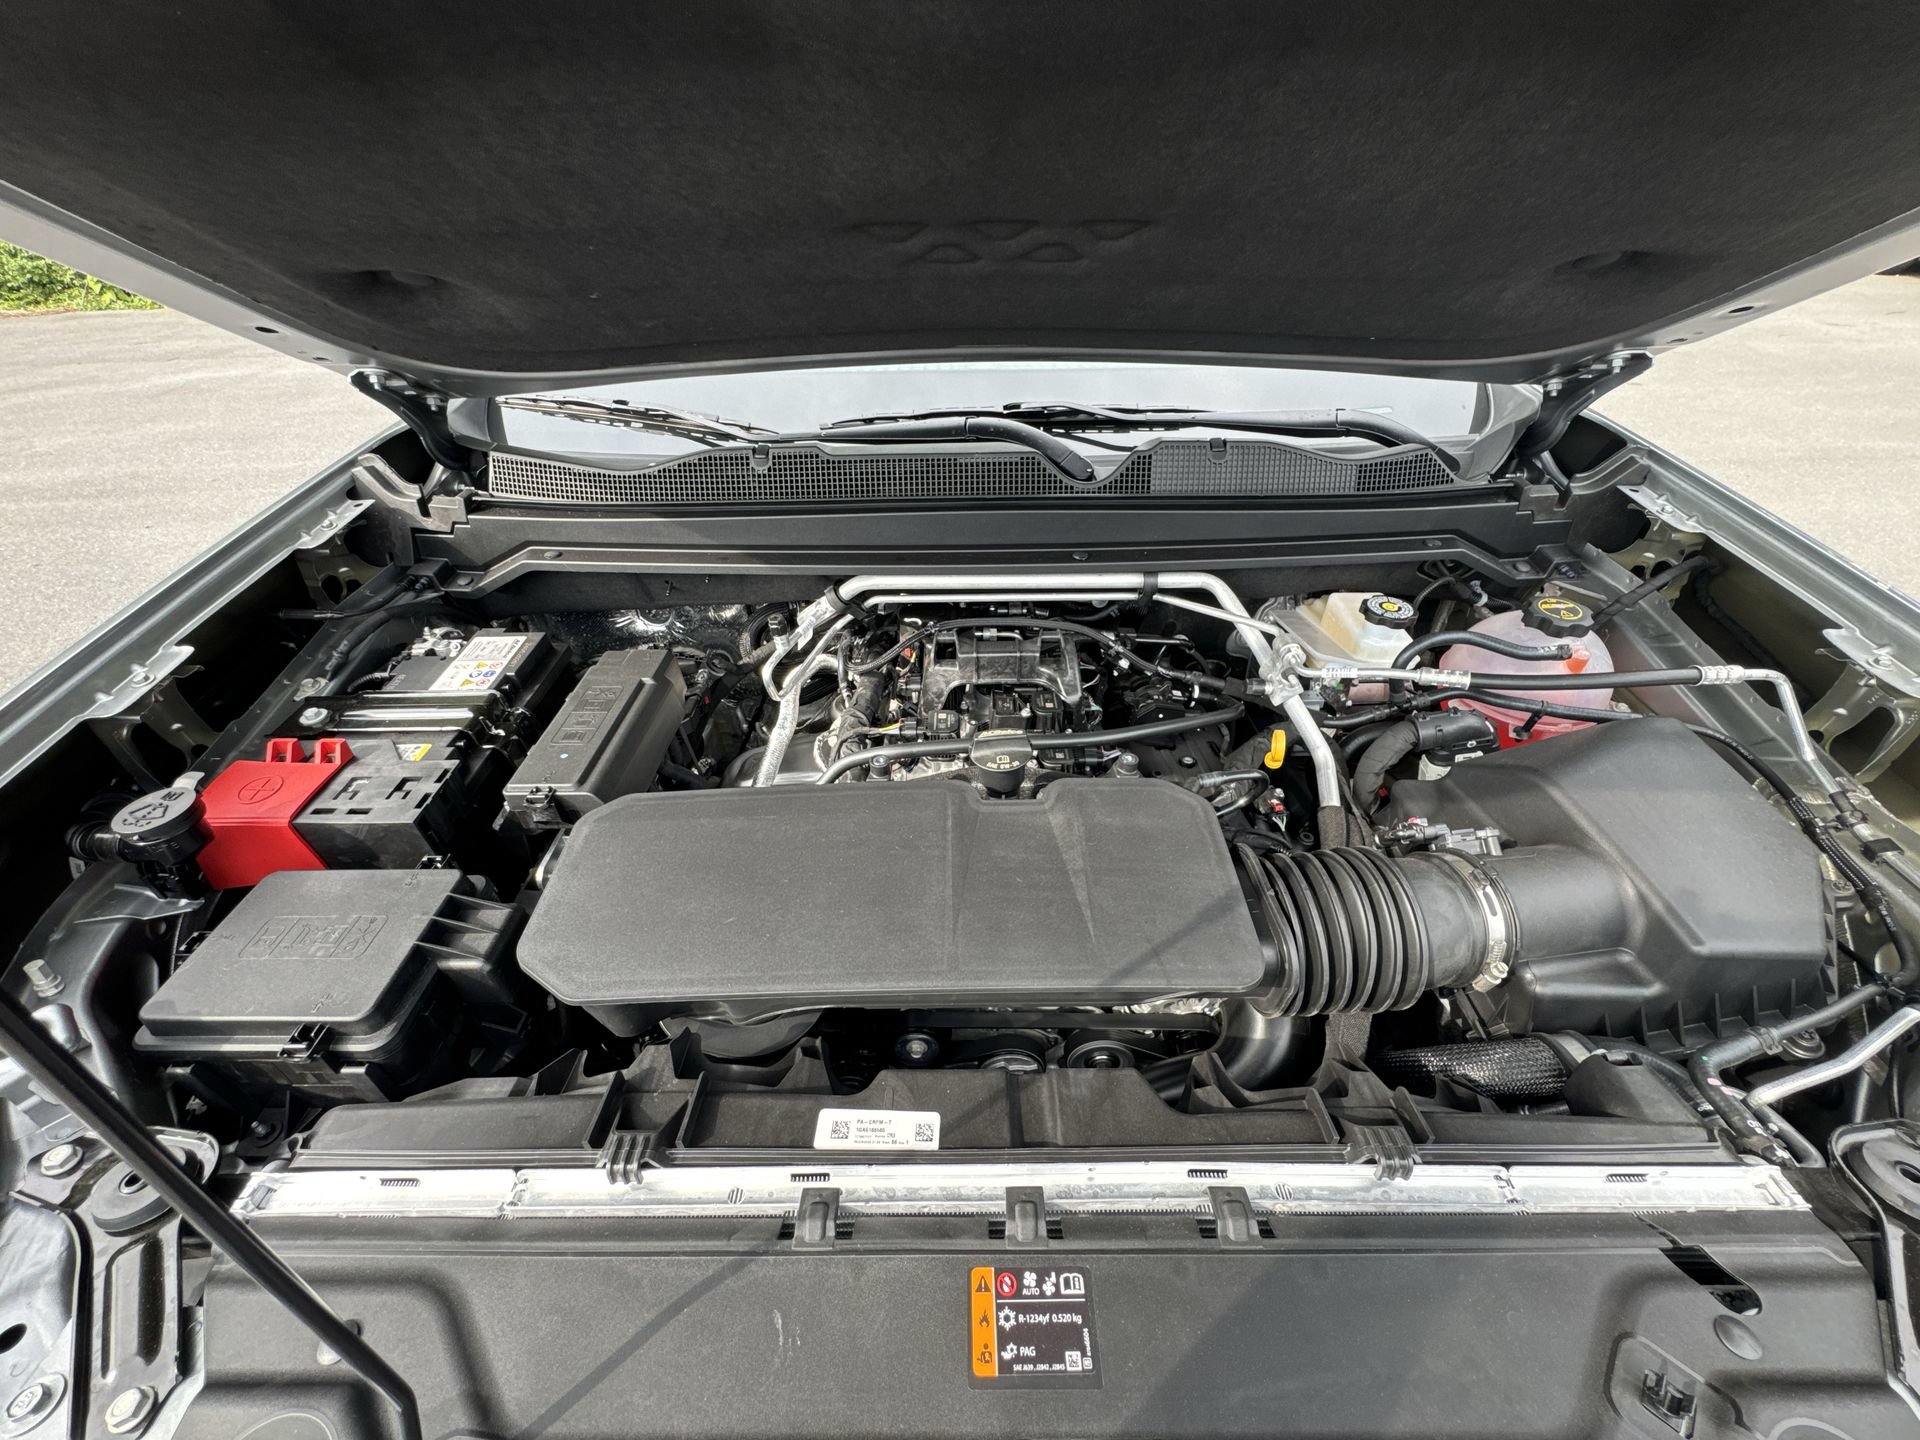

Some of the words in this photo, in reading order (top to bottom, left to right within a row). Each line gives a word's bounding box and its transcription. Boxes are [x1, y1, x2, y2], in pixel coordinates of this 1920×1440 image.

[1022, 1287, 1040, 1296] AUTO
[1018, 1313, 1050, 1325] R-1234yf
[1052, 1314, 1071, 1323] 0.520
[1072, 1313, 1082, 1325] kg
[1019, 1346, 1036, 1357] PAG
